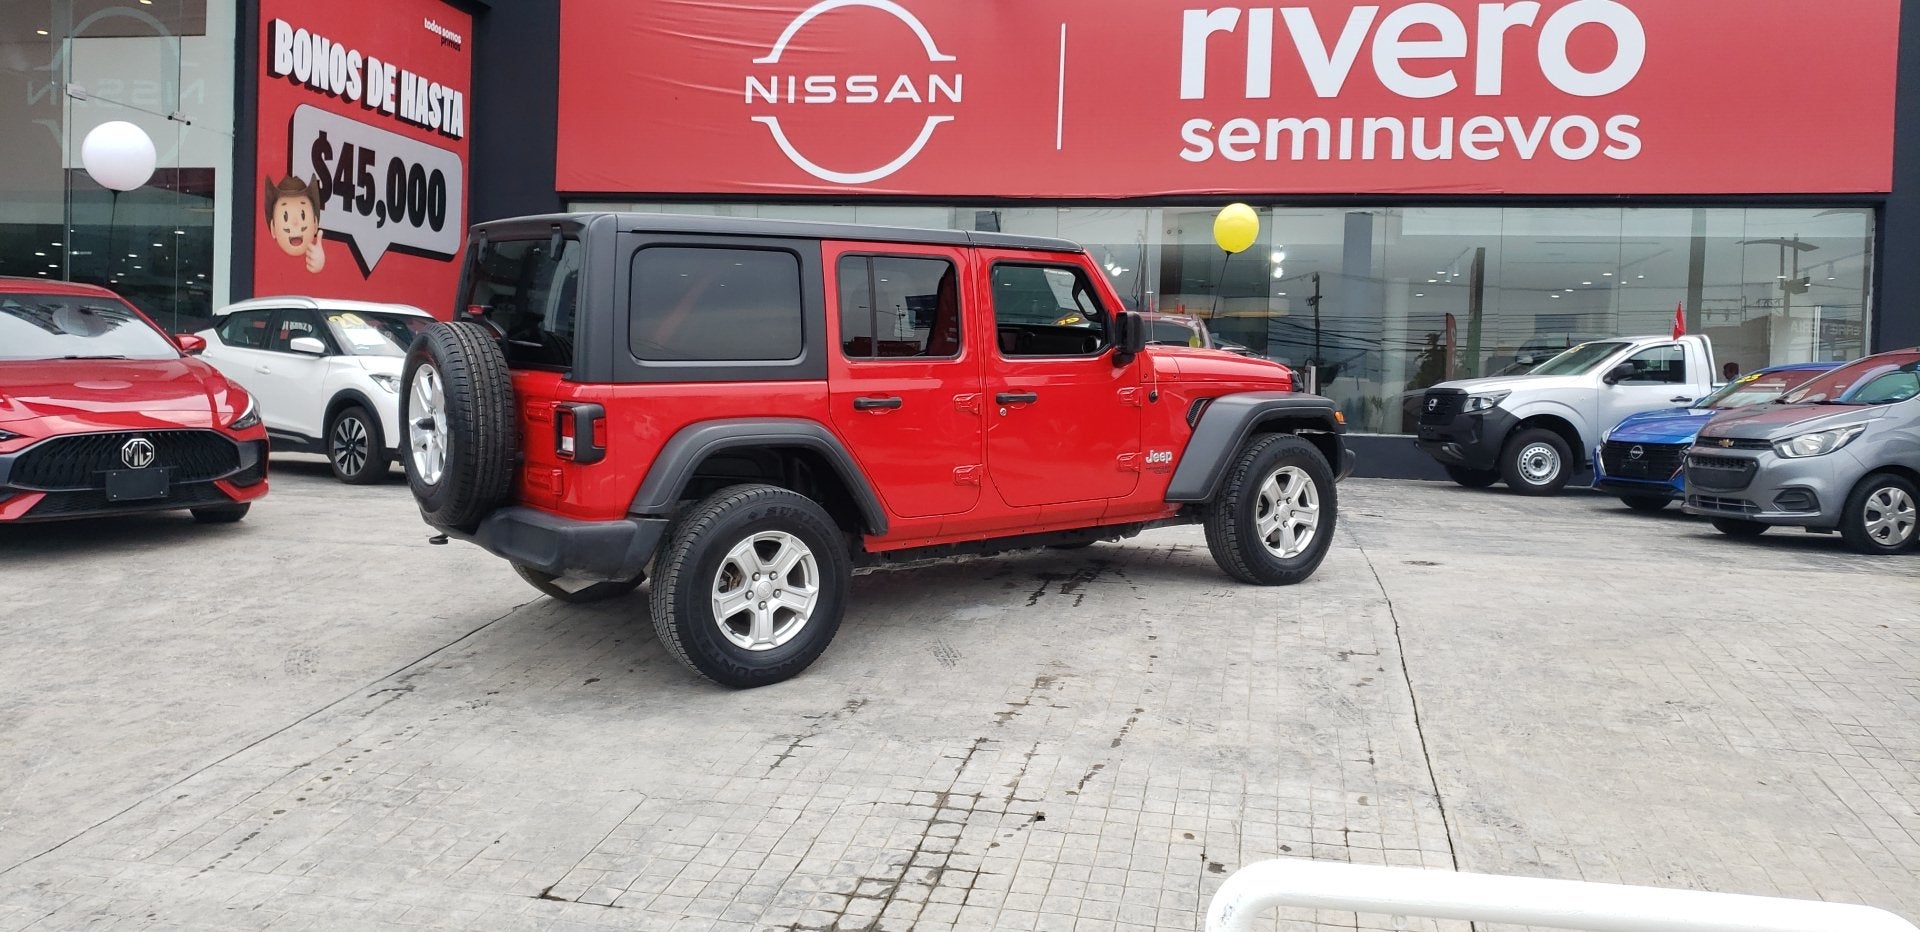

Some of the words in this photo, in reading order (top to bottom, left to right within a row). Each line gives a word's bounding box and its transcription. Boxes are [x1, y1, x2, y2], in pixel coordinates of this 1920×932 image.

[424, 17, 442, 35] todos
[442, 28, 462, 44] somos
[1179, 0, 1646, 100] rivero
[273, 18, 362, 101] BONOS
[366, 56, 396, 114] DE
[400, 69, 464, 138] HASTA
[745, 73, 963, 104] NISSAN
[1179, 114, 1642, 162] seminuevos
[311, 130, 446, 232] $45,000
[124, 440, 153, 468] MG
[1145, 449, 1173, 464] Jeep
